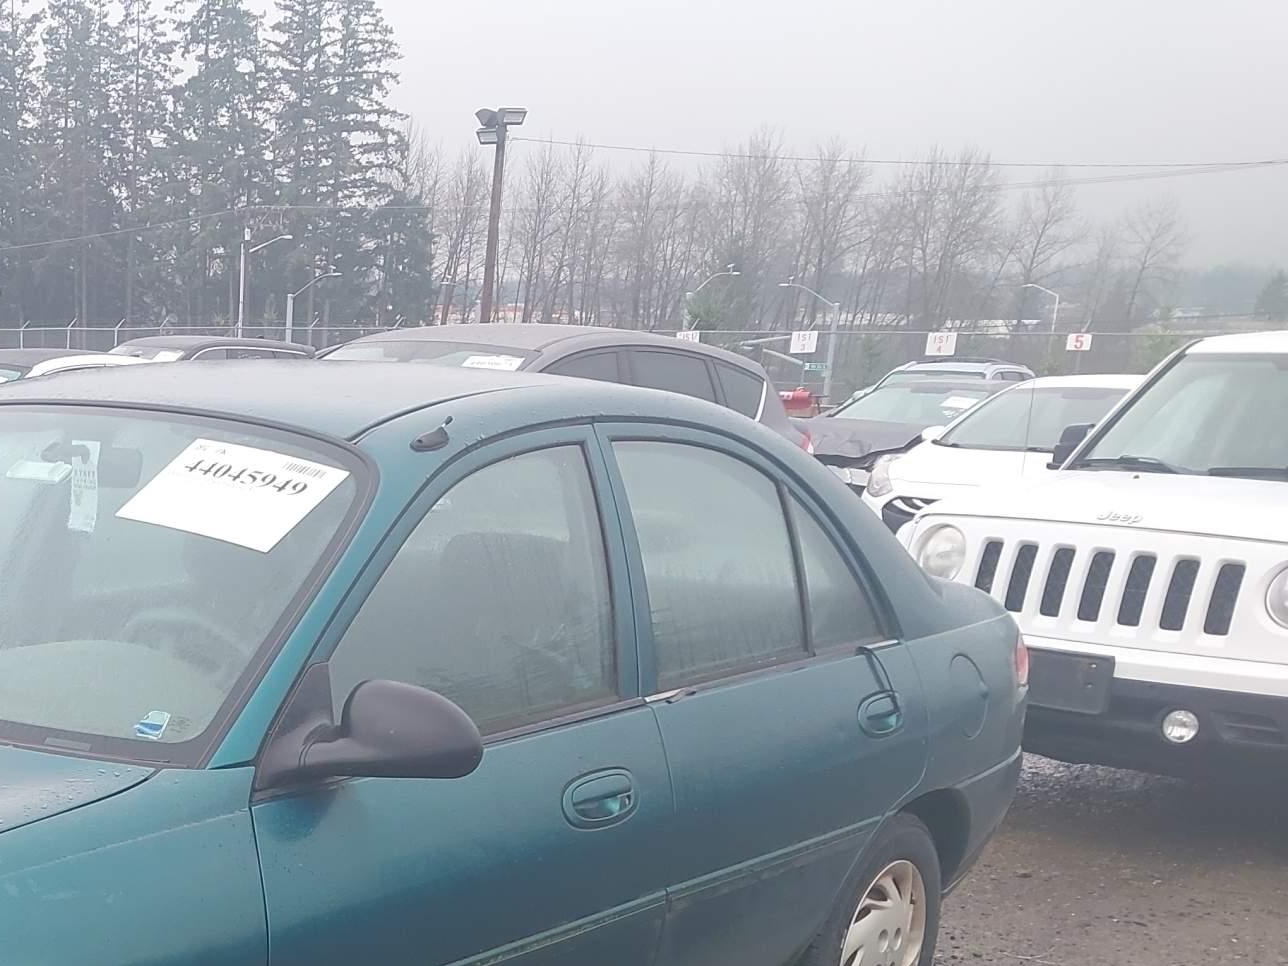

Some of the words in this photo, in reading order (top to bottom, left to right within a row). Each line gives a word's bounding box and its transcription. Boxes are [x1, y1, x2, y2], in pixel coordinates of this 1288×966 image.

[1074, 334, 1085, 349] 5
[184, 459, 308, 496] 44045949
[1096, 511, 1143, 525] Jeep
